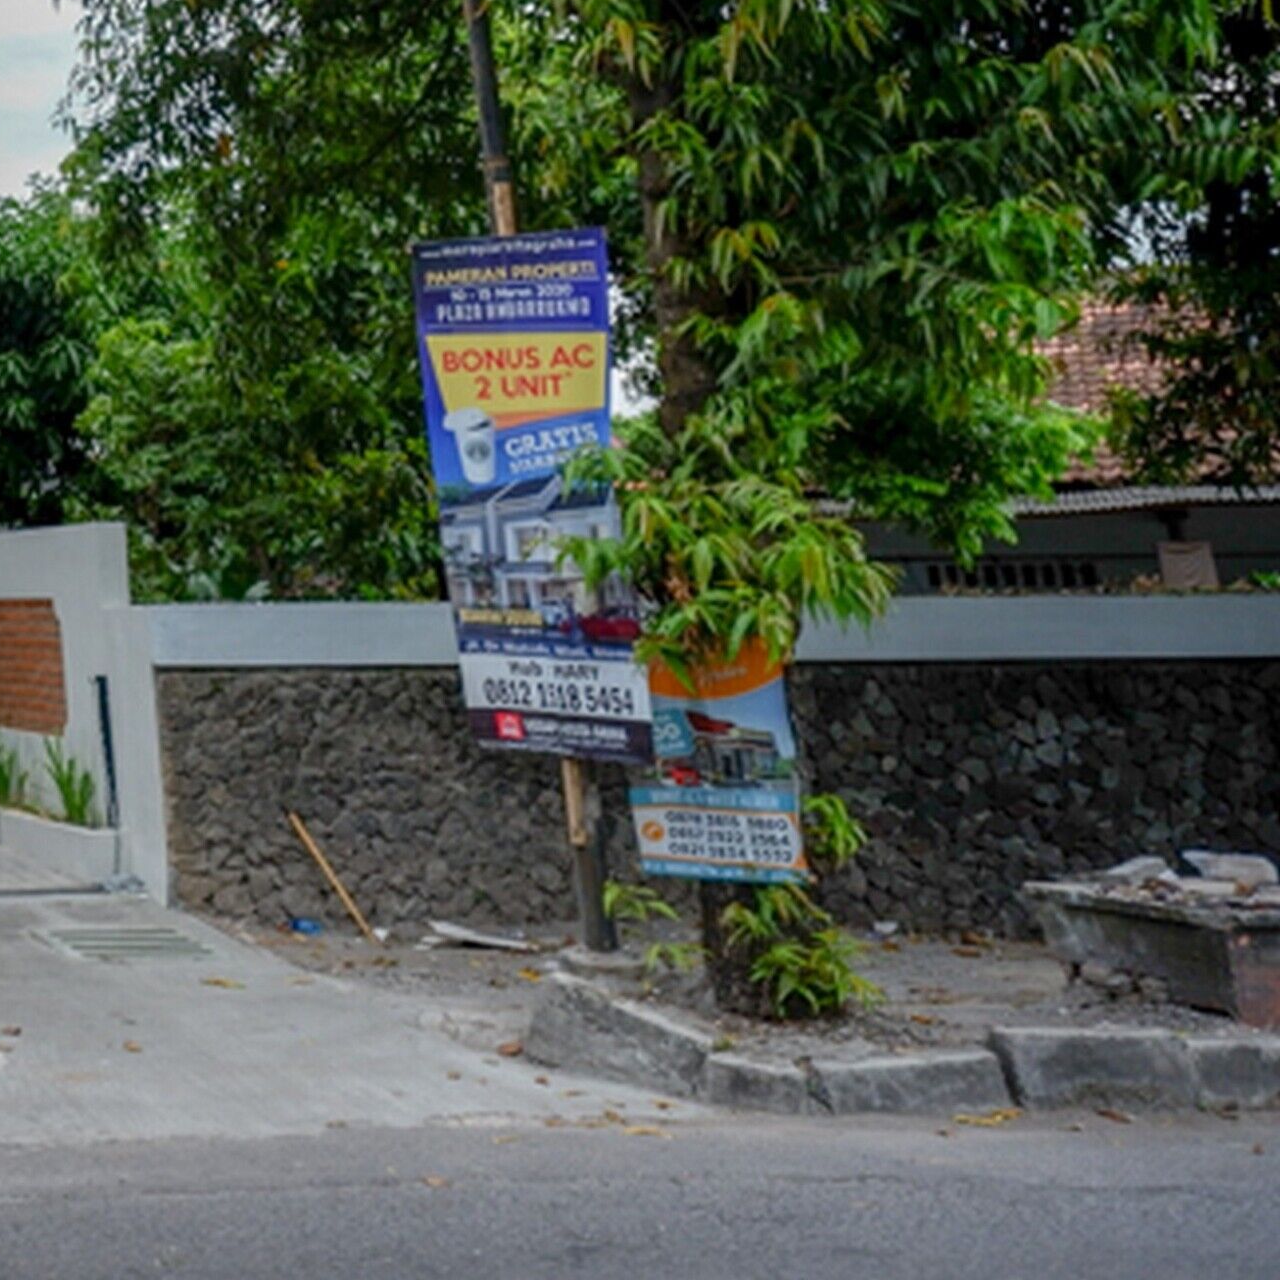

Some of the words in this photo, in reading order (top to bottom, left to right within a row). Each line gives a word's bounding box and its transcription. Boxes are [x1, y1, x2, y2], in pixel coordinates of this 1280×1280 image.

[424, 266, 508, 286] PAMERAN
[510, 261, 598, 279] PROPERTI
[436, 302, 482, 323] PLAZA
[442, 346, 542, 372] BONUS
[549, 343, 595, 369] AC
[474, 376, 492, 400] 2
[505, 422, 599, 457] GRATIS
[482, 677, 532, 706] 0812
[585, 686, 635, 715] 5454
